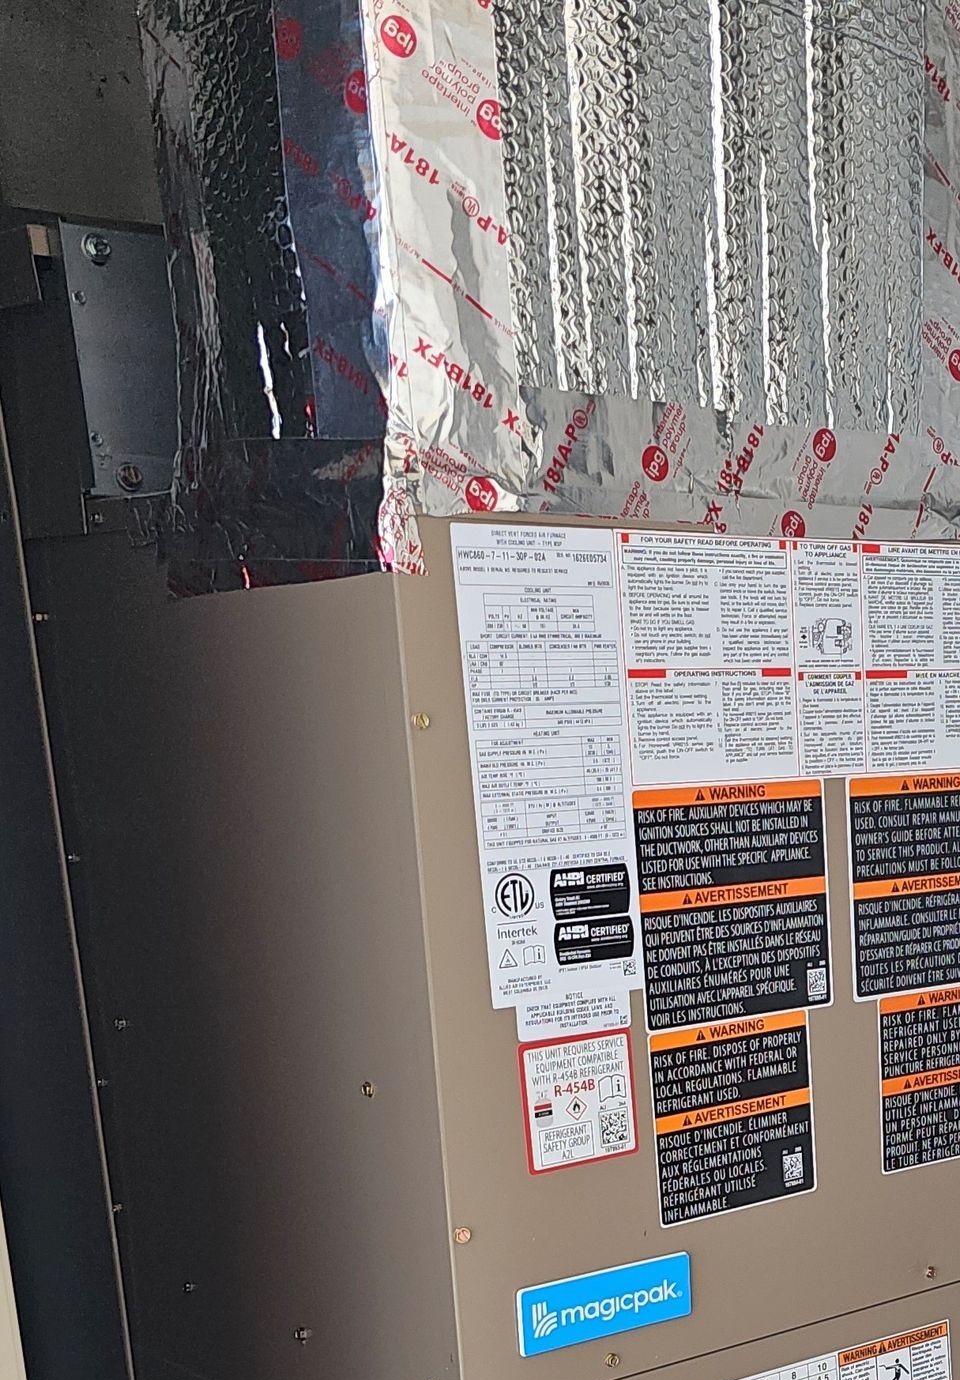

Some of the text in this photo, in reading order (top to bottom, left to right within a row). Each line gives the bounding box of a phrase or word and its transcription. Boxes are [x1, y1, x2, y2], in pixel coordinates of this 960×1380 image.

[413, 336, 494, 410] 181B-FX
[814, 429, 836, 461] ipg
[643, 447, 669, 481] ipg
[710, 785, 765, 800] WARNING
[913, 776, 960, 790] WARNING
[586, 871, 625, 885] CERTIFIED
[695, 882, 789, 904] AVERTISSEMENT
[497, 926, 538, 940] Intertek
[591, 924, 629, 937] CERTIFIED
[710, 1019, 764, 1039] WARNING
[528, 1037, 624, 1063] THIS UNIT REQUIRES SERVICE
[536, 1050, 618, 1074] EQUIPMENT COMPATIBLE
[653, 1031, 802, 1069] RISK OF FIRE. DISPOSE OF PROPERLY
[532, 1061, 623, 1086] WITH R-454B REFRIGERANT
[655, 1047, 797, 1084] IN ACCORDANCE WITH FEDERAL OR
[554, 1078, 595, 1097] R-454B
[656, 1061, 797, 1099] LOCAL REGULATIONS. FLAMMABLE
[657, 1087, 741, 1114] REFRIGERANT USED.
[694, 1095, 787, 1125] AVERTISSEMENT
[543, 1135, 590, 1153] SAFETY GROUP
[545, 1124, 587, 1141] REFRIGERANT
[562, 1149, 574, 1159] A2L
[561, 1278, 678, 1325] magicpak
[842, 1326, 944, 1363] WARNING AVERTISSEMENT
[791, 1371, 797, 1380] 8
[817, 1362, 827, 1372] 10
